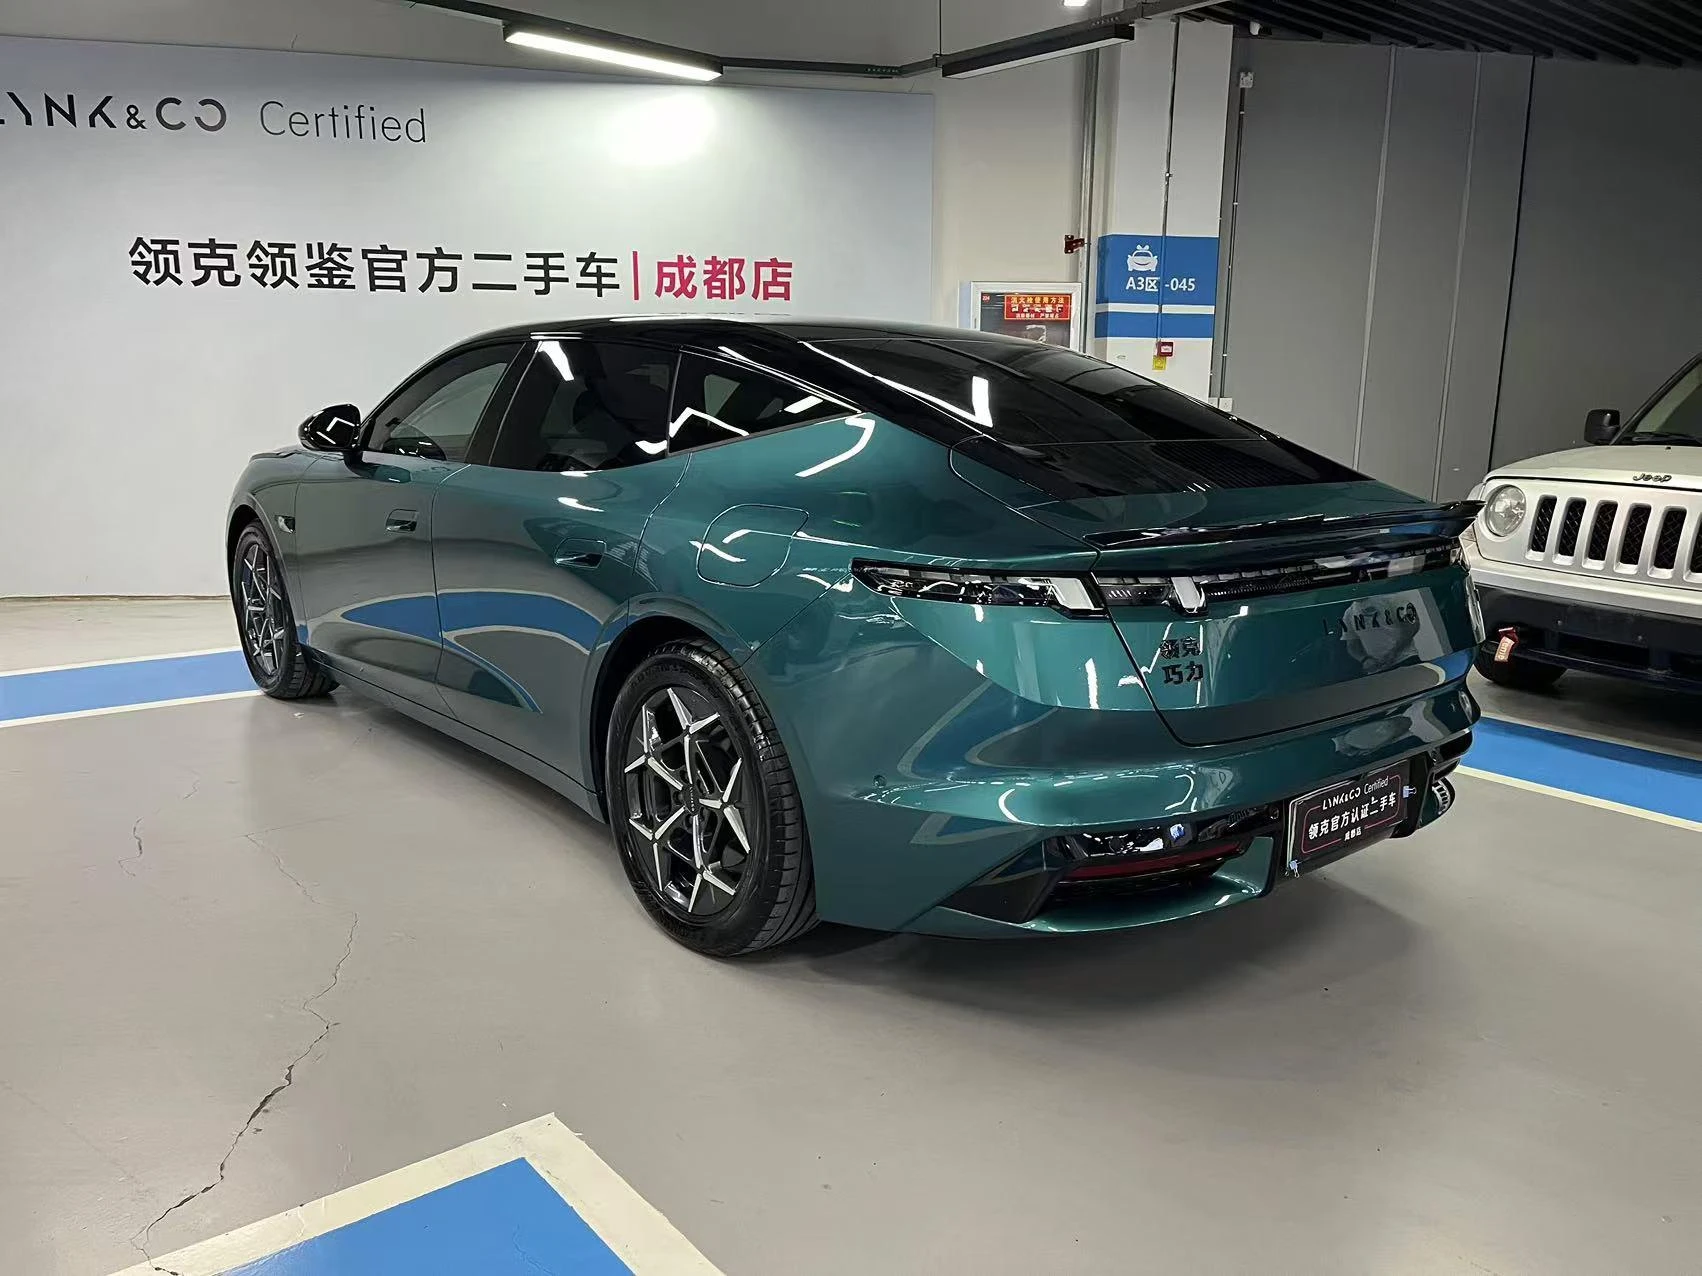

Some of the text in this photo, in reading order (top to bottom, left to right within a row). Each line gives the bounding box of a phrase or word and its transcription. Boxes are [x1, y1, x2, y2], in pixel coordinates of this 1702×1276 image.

[0, 91, 427, 143] YNK&CO Certified
[128, 236, 793, 301] 领克领鉴官方二手车 成都店
[1632, 473, 1672, 483] Jeep
[1162, 661, 1204, 685] 巧力
[1363, 775, 1389, 795] Certified
[1308, 791, 1397, 841] 领克官方认证二手车
